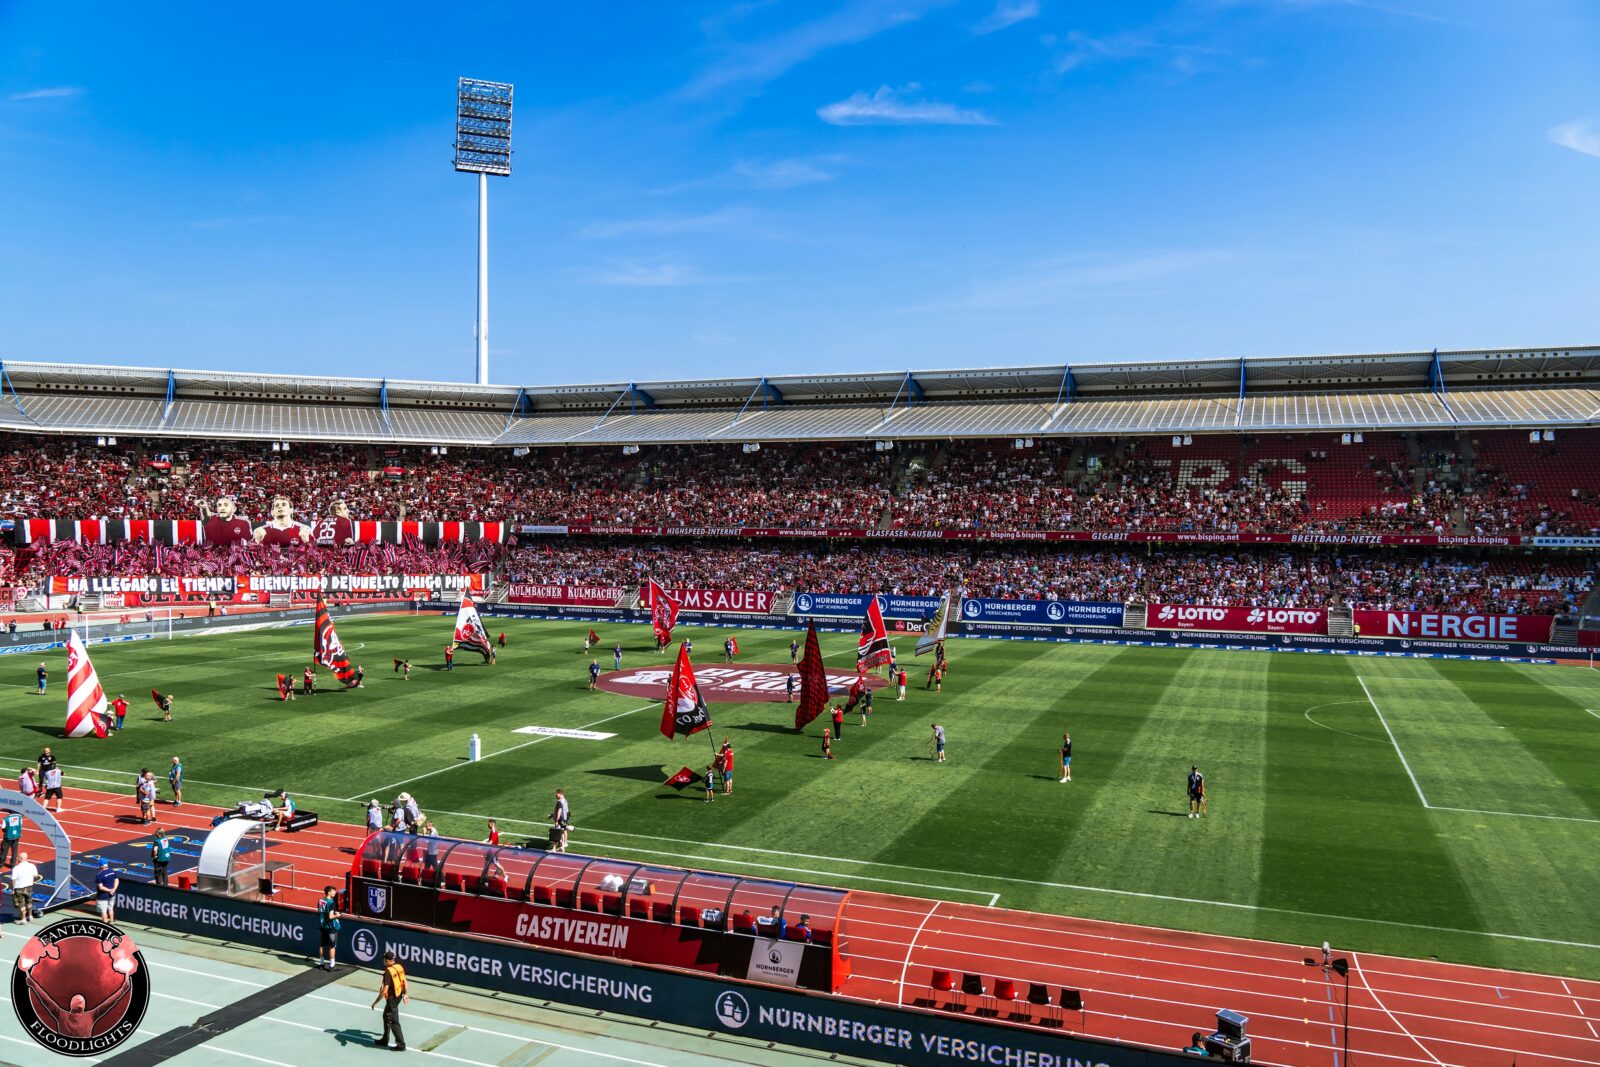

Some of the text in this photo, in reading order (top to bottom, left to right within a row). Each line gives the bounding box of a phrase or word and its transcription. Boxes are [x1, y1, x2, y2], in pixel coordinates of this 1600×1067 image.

[319, 521, 336, 540] 25
[666, 527, 743, 535] HIGHSPEED-INTERNET
[778, 529, 828, 537] www.bisping.net
[866, 530, 943, 538] GLASFASER-AUSBAU
[990, 531, 1014, 540] bisping
[1021, 531, 1046, 540] bisping
[1177, 533, 1239, 542] www.bisping.net
[1291, 534, 1382, 544] BREITBAND-NETZE
[1438, 535, 1469, 546] bisping
[1477, 536, 1509, 546] bisping
[68, 577, 89, 592] HA
[93, 577, 157, 592] LLEGADO
[161, 577, 178, 591] EL
[182, 577, 232, 591] TIEMPO
[250, 576, 328, 591] BIENVENIDO
[331, 575, 348, 589] DE
[402, 575, 441, 589] AMIGO
[509, 585, 562, 598] KULMBACHER
[815, 597, 862, 605] NÜRNBERGER
[890, 599, 940, 608] NÜRNBERGER
[984, 602, 1037, 612] NÜRNBERGER
[1068, 605, 1122, 614] NÜRNBERGER
[1177, 607, 1226, 621] LOTTO
[1267, 611, 1317, 624] LOTTO
[906, 622, 922, 632] Der
[1076, 627, 1113, 635] NÜRNBERGER
[1181, 631, 1267, 641] NÜRNBERGER VERSICHERUNG
[1294, 636, 1384, 646] NÜRNBERGER VERSICHERUNG
[1413, 640, 1509, 650] NÜRNBERGER VERSICHERUNG
[116, 892, 304, 941] RNBERGER VERSICHERUNG
[515, 912, 630, 949] GASTVEREIN
[385, 941, 652, 1004] NÜRNBERGER VERSICHERUNG
[755, 963, 795, 974] NÜRNBERGER
[759, 1004, 1110, 1067] NÜRNBERGER VERSICHERU
